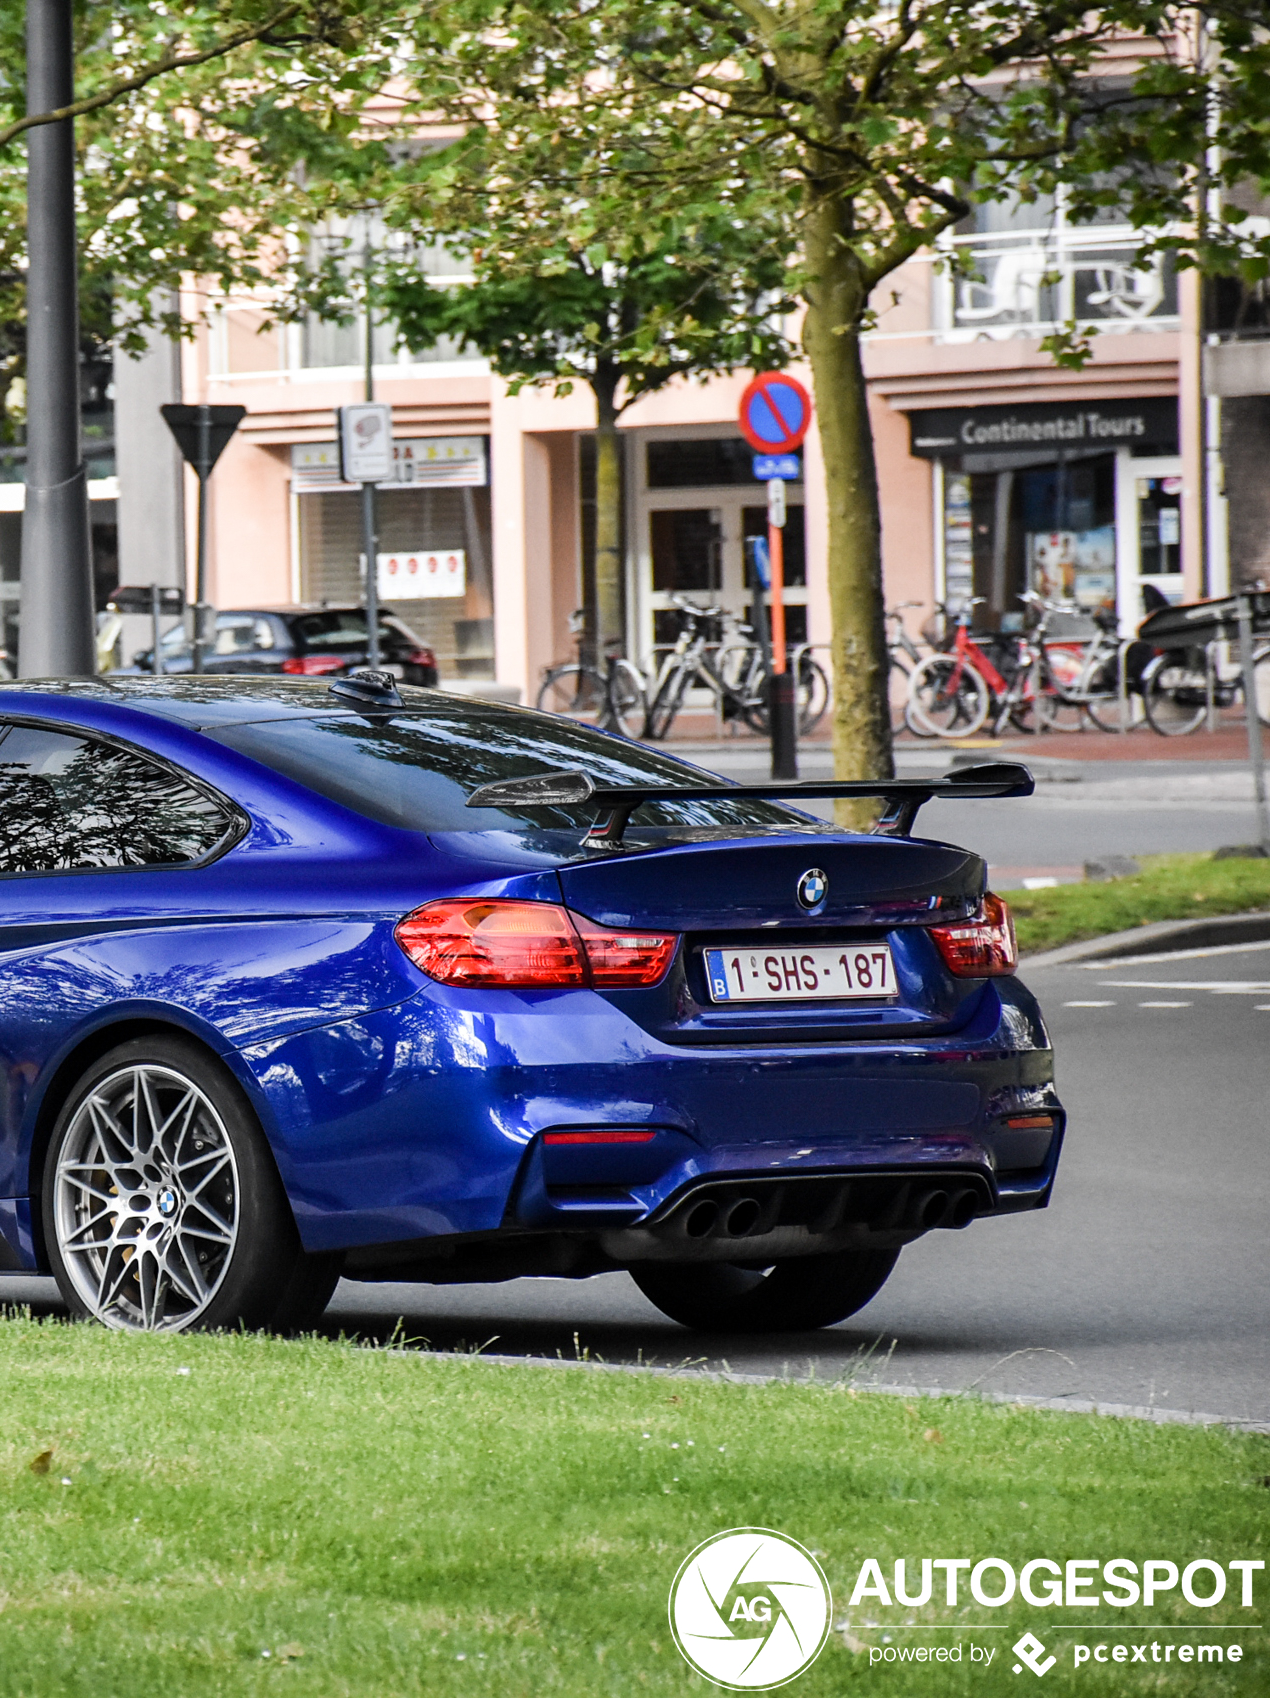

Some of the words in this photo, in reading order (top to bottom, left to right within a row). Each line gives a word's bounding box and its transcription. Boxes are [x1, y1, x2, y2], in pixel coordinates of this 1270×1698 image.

[961, 412, 1085, 444] Continental
[1087, 411, 1145, 438] Tours
[714, 978, 726, 996] B
